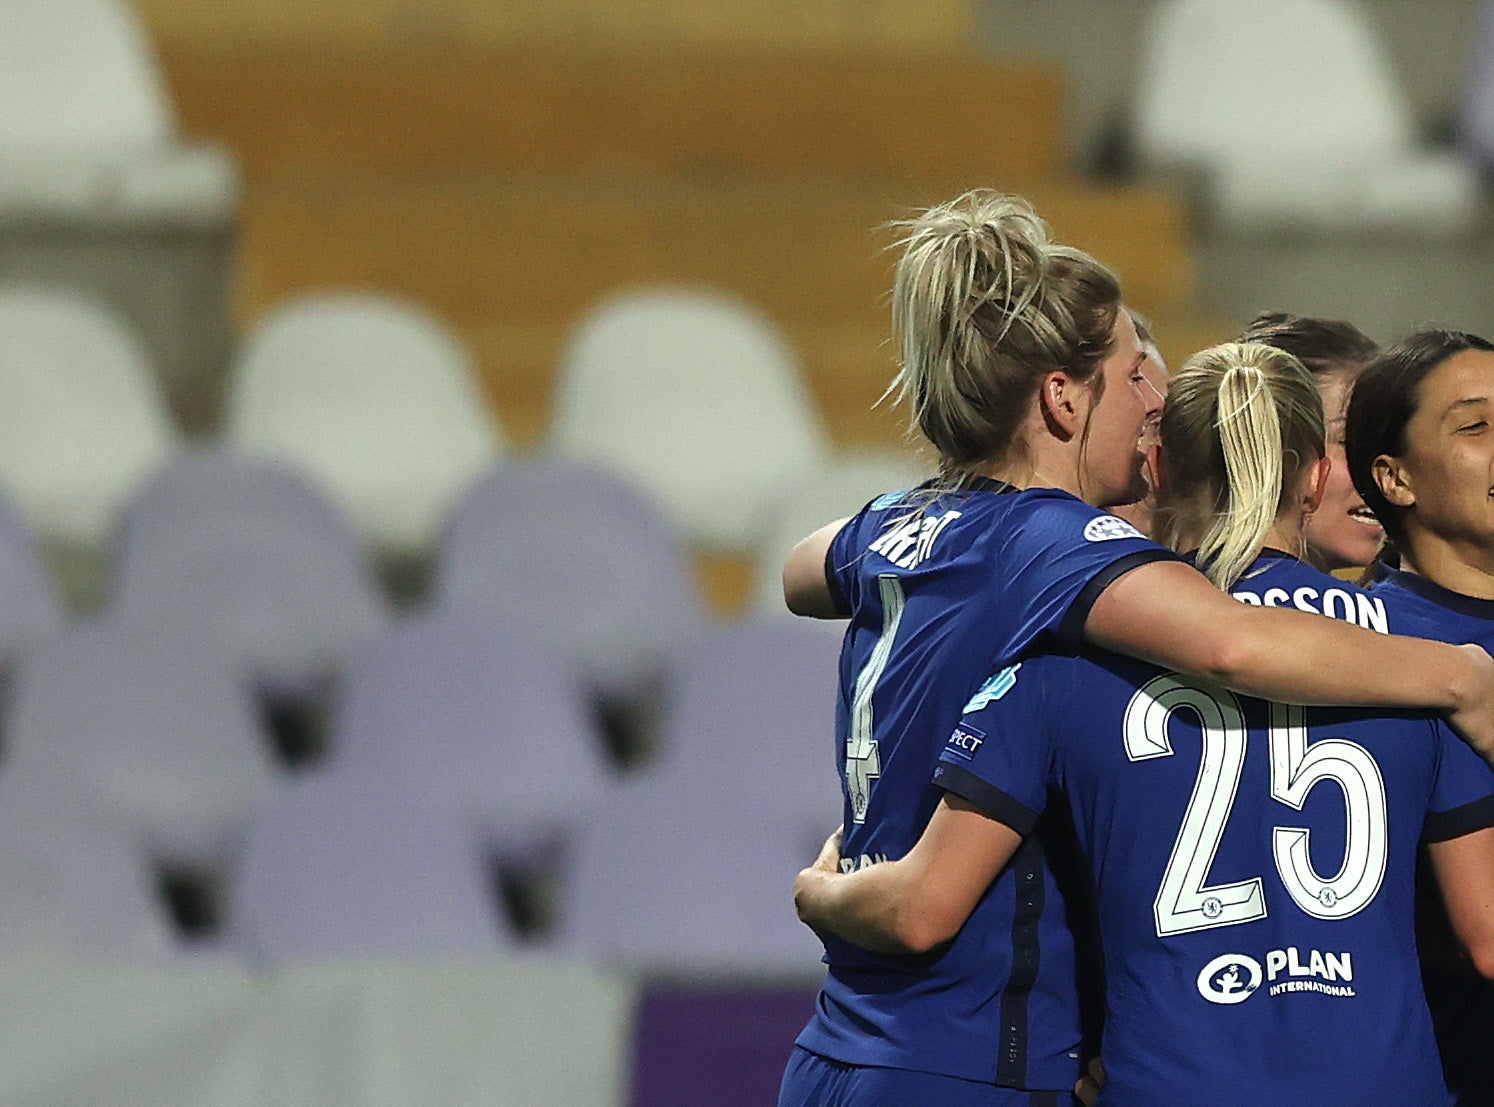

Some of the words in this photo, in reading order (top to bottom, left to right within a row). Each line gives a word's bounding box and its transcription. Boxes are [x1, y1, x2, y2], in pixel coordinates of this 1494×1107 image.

[1123, 672, 1388, 936] 25
[1266, 946, 1353, 982] PLAN
[1270, 981, 1356, 997] INTERNATIONAL
